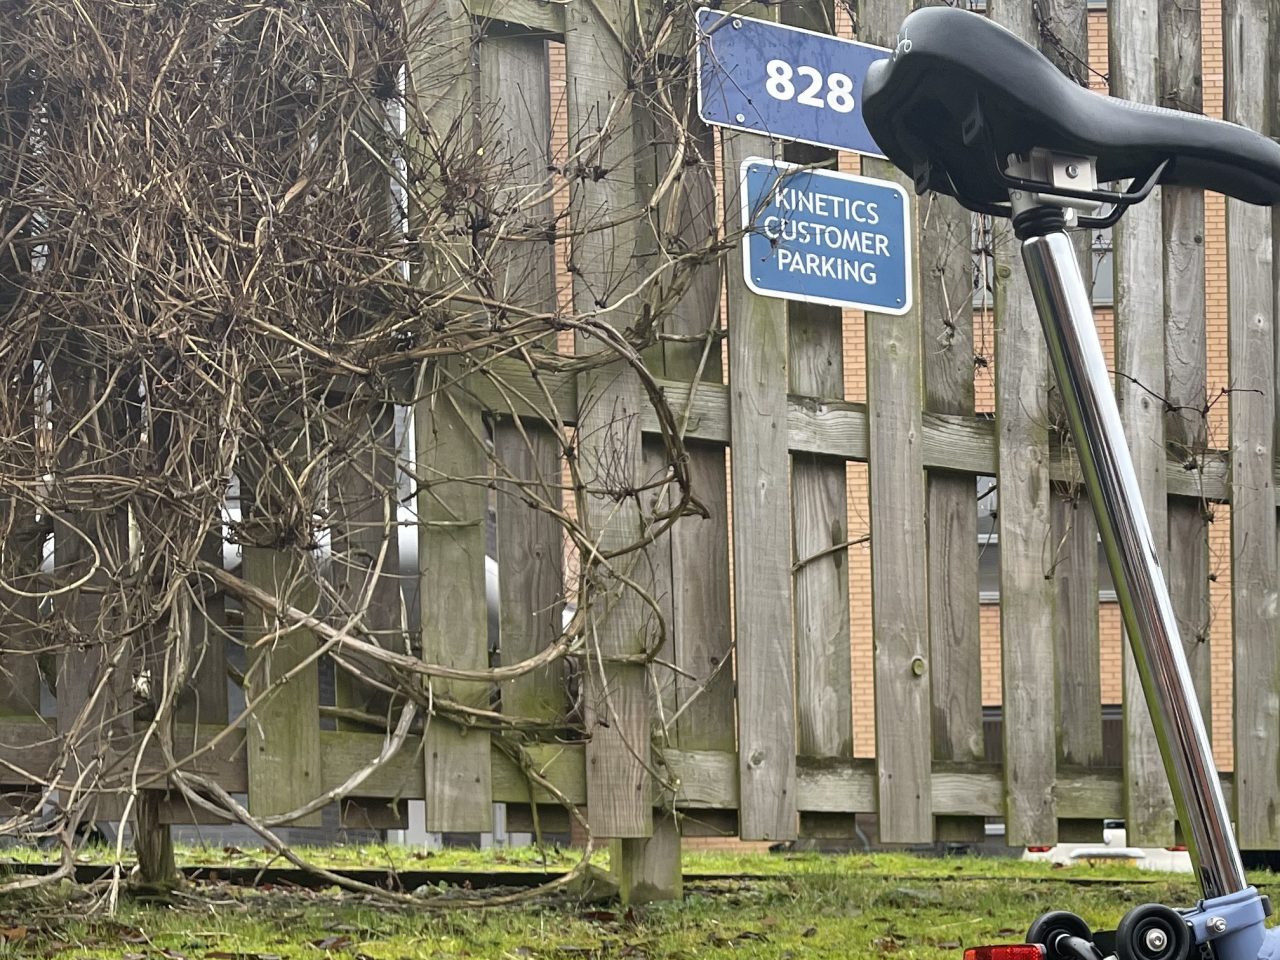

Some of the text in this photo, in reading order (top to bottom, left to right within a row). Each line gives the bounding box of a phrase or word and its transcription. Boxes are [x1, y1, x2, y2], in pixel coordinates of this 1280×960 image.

[766, 59, 855, 113] 828
[775, 187, 879, 225] KINETICS
[764, 216, 890, 257] CUSTOMER
[778, 248, 877, 285] PARKING
